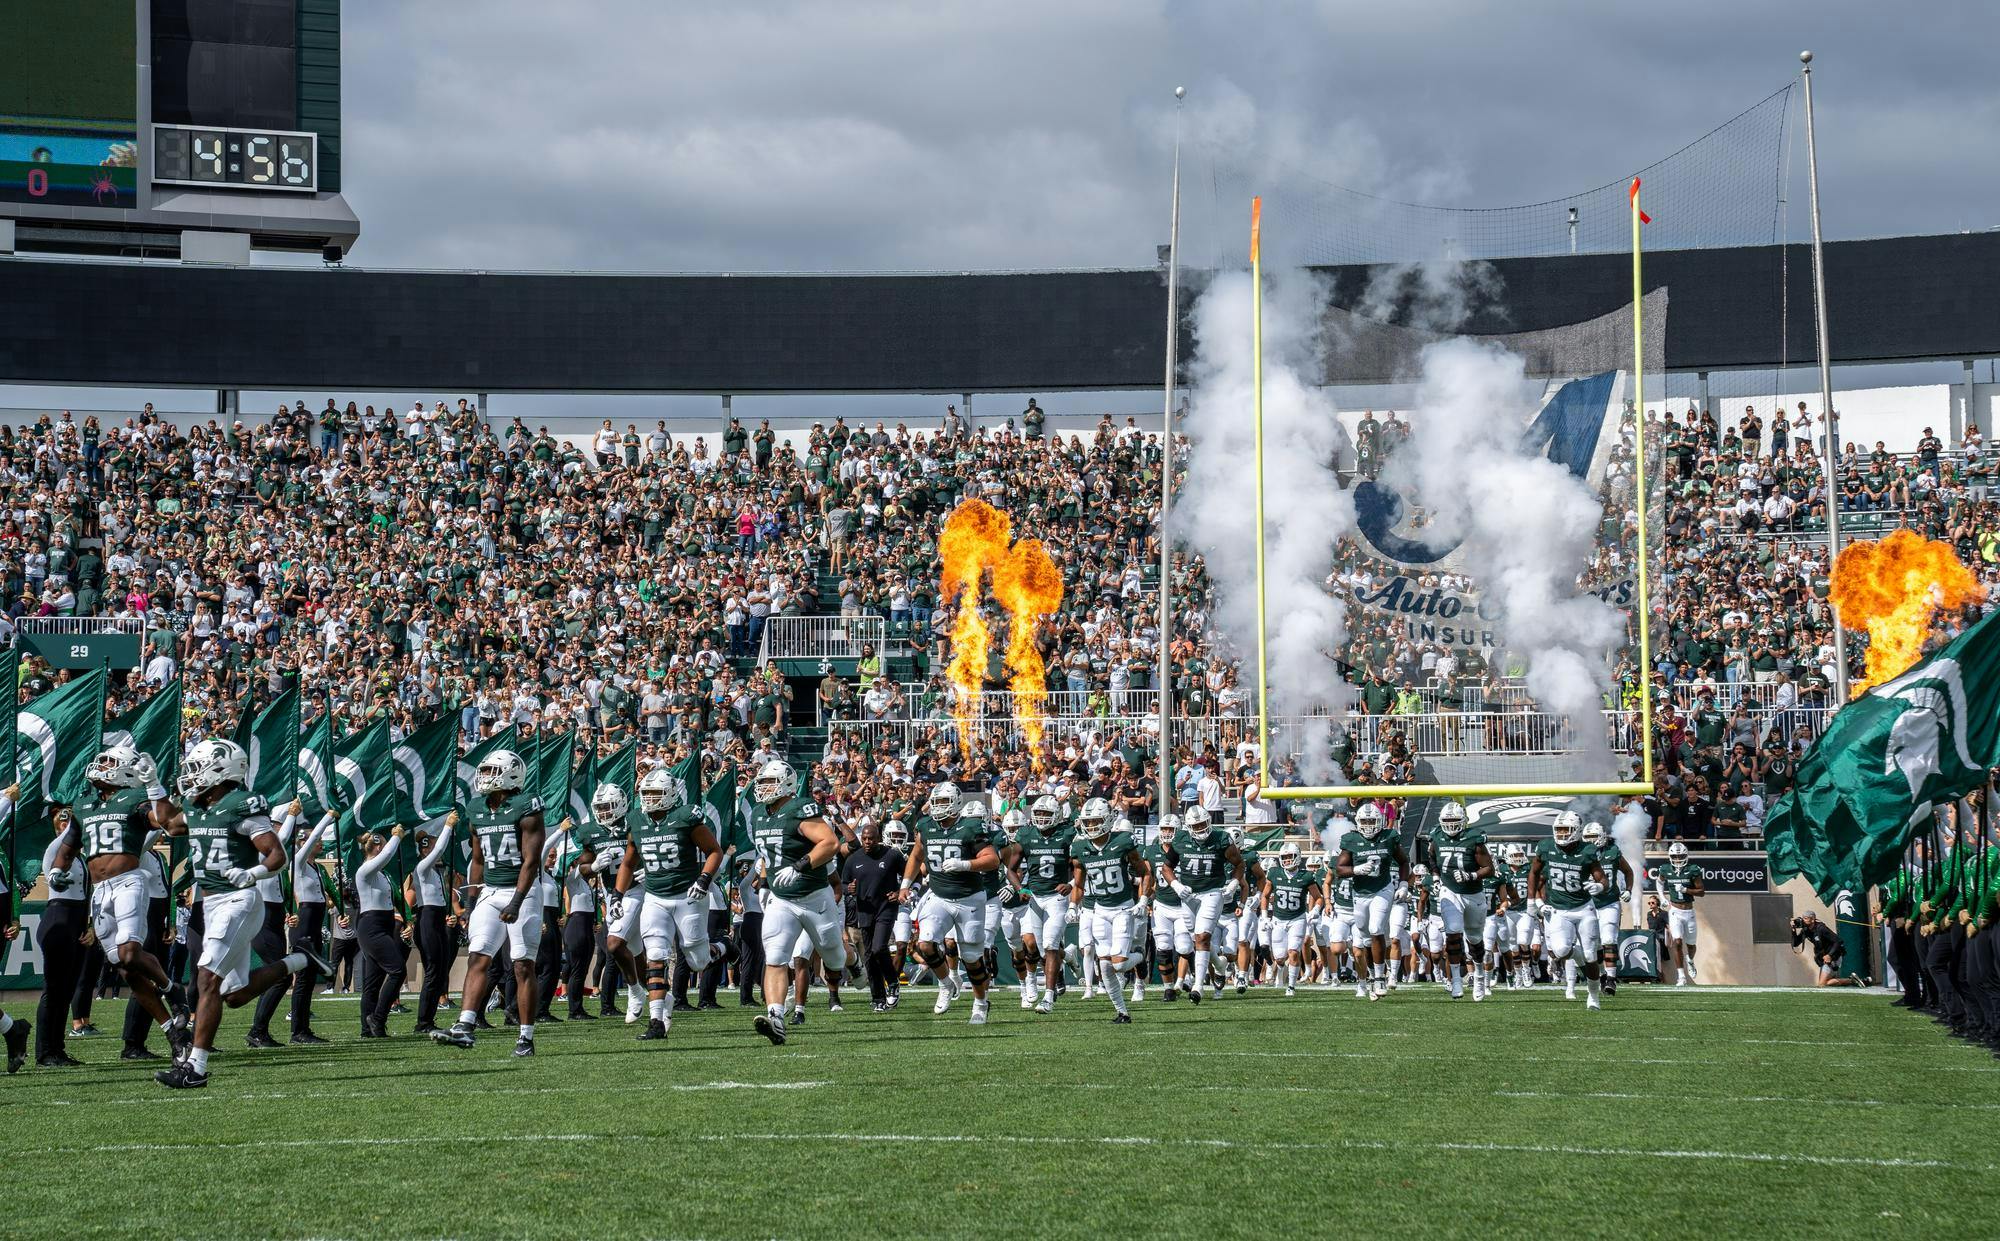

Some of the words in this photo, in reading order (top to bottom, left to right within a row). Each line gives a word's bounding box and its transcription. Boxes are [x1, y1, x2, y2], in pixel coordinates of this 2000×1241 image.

[28, 169, 48, 197] 0
[70, 645, 89, 658] 29
[249, 794, 268, 814] 24
[802, 802, 819, 817] 97
[83, 813, 107, 824] MICHIGAN
[108, 812, 128, 821] STATE
[85, 821, 123, 856] 19
[208, 827, 228, 836] STATE
[476, 825, 498, 836] MICHIGAN
[498, 824, 516, 833] STATE
[640, 835, 663, 844] MICHIGAN
[663, 833, 679, 842] STATE
[480, 832, 523, 870] 44
[594, 841, 618, 851] MICHIGAN
[926, 838, 948, 846] MICHIGAN
[948, 838, 963, 846] STATE
[188, 837, 236, 878] 24
[641, 842, 681, 873] 53
[755, 836, 784, 869] 97
[1440, 851, 1466, 874] 71
[1084, 859, 1107, 869] MICHIGAN
[1106, 857, 1121, 866] STATE
[1185, 858, 1213, 876] 41
[1086, 865, 1125, 897] 29
[1550, 868, 1582, 893] 26
[1275, 889, 1301, 911] 35
